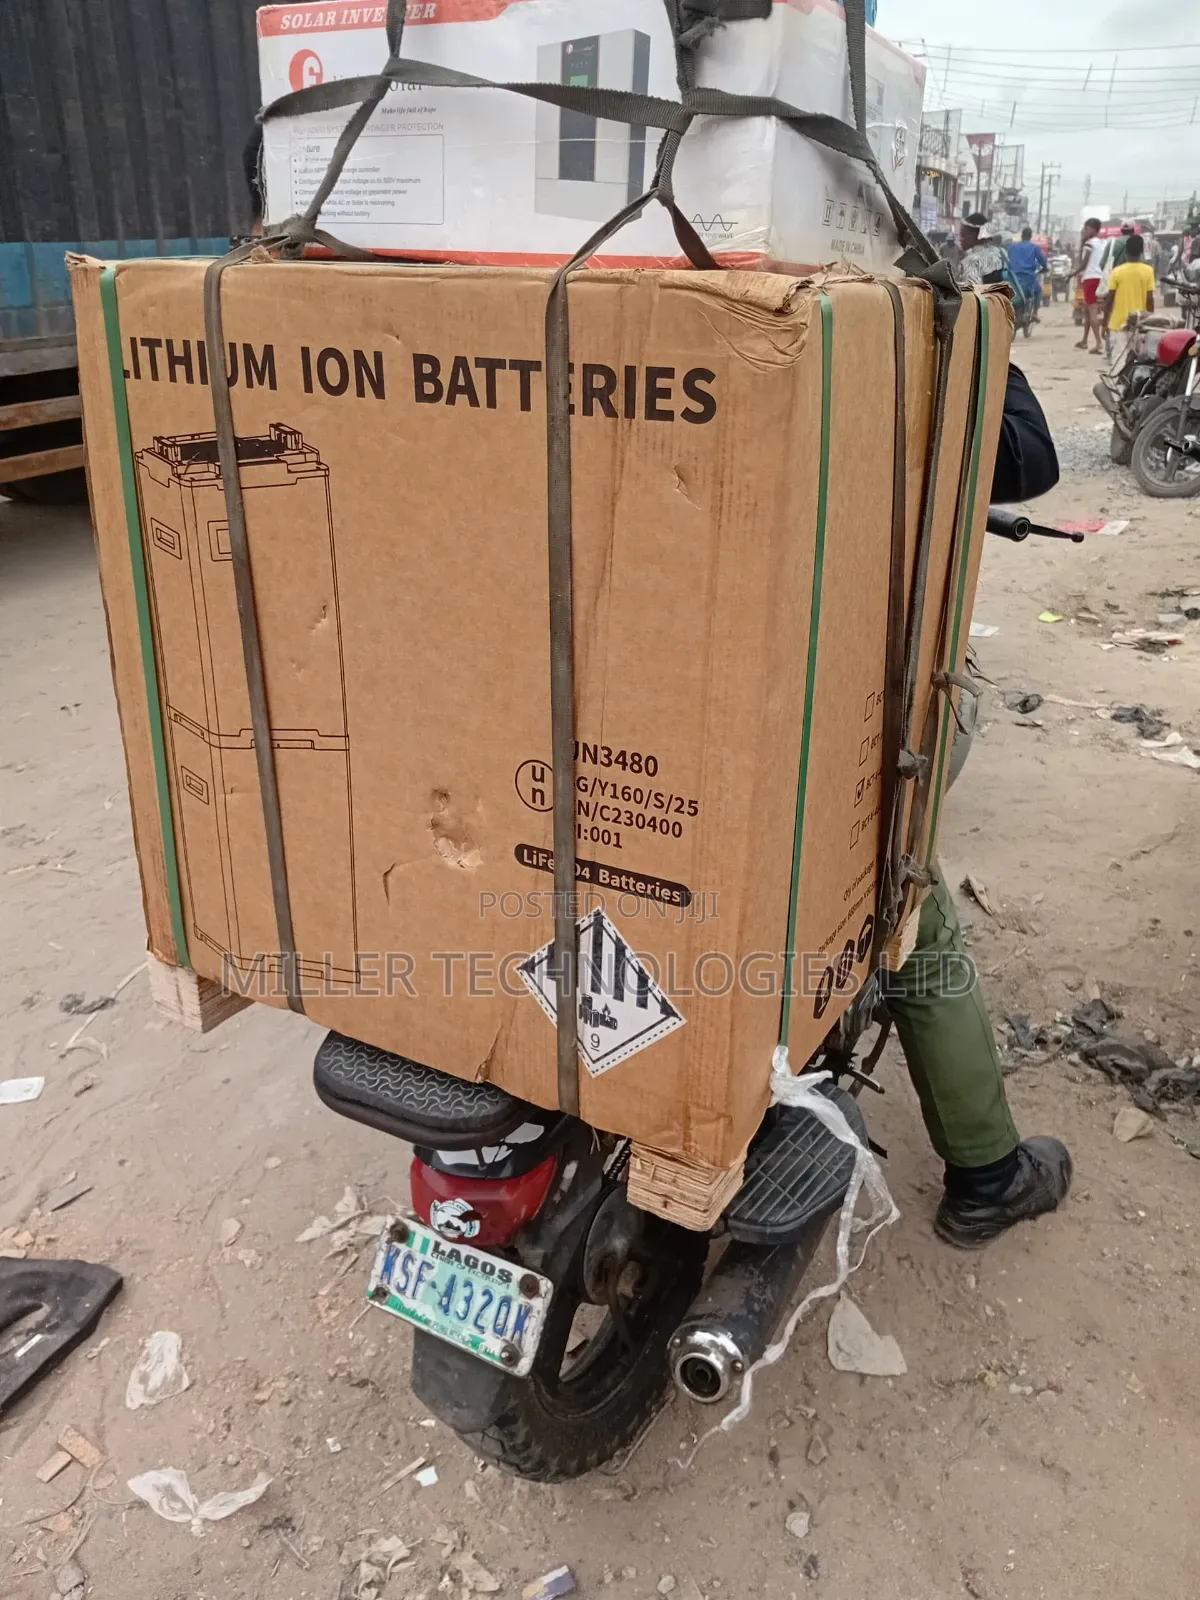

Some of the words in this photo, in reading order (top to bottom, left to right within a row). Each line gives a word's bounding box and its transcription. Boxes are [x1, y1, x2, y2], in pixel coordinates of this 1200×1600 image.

[280, 11, 336, 30] SOLAR
[340, 2, 437, 25] INVEER
[124, 336, 278, 391] ITHIUM
[300, 345, 387, 400] ION
[413, 353, 717, 425] BATTRIES
[575, 775, 699, 817] G/Y160/S/25
[575, 799, 683, 839] N/C230400
[575, 823, 623, 849] I:001
[523, 848, 591, 880] LiFe4
[598, 868, 681, 903] Batteries
[432, 1240, 513, 1284] LAGOS
